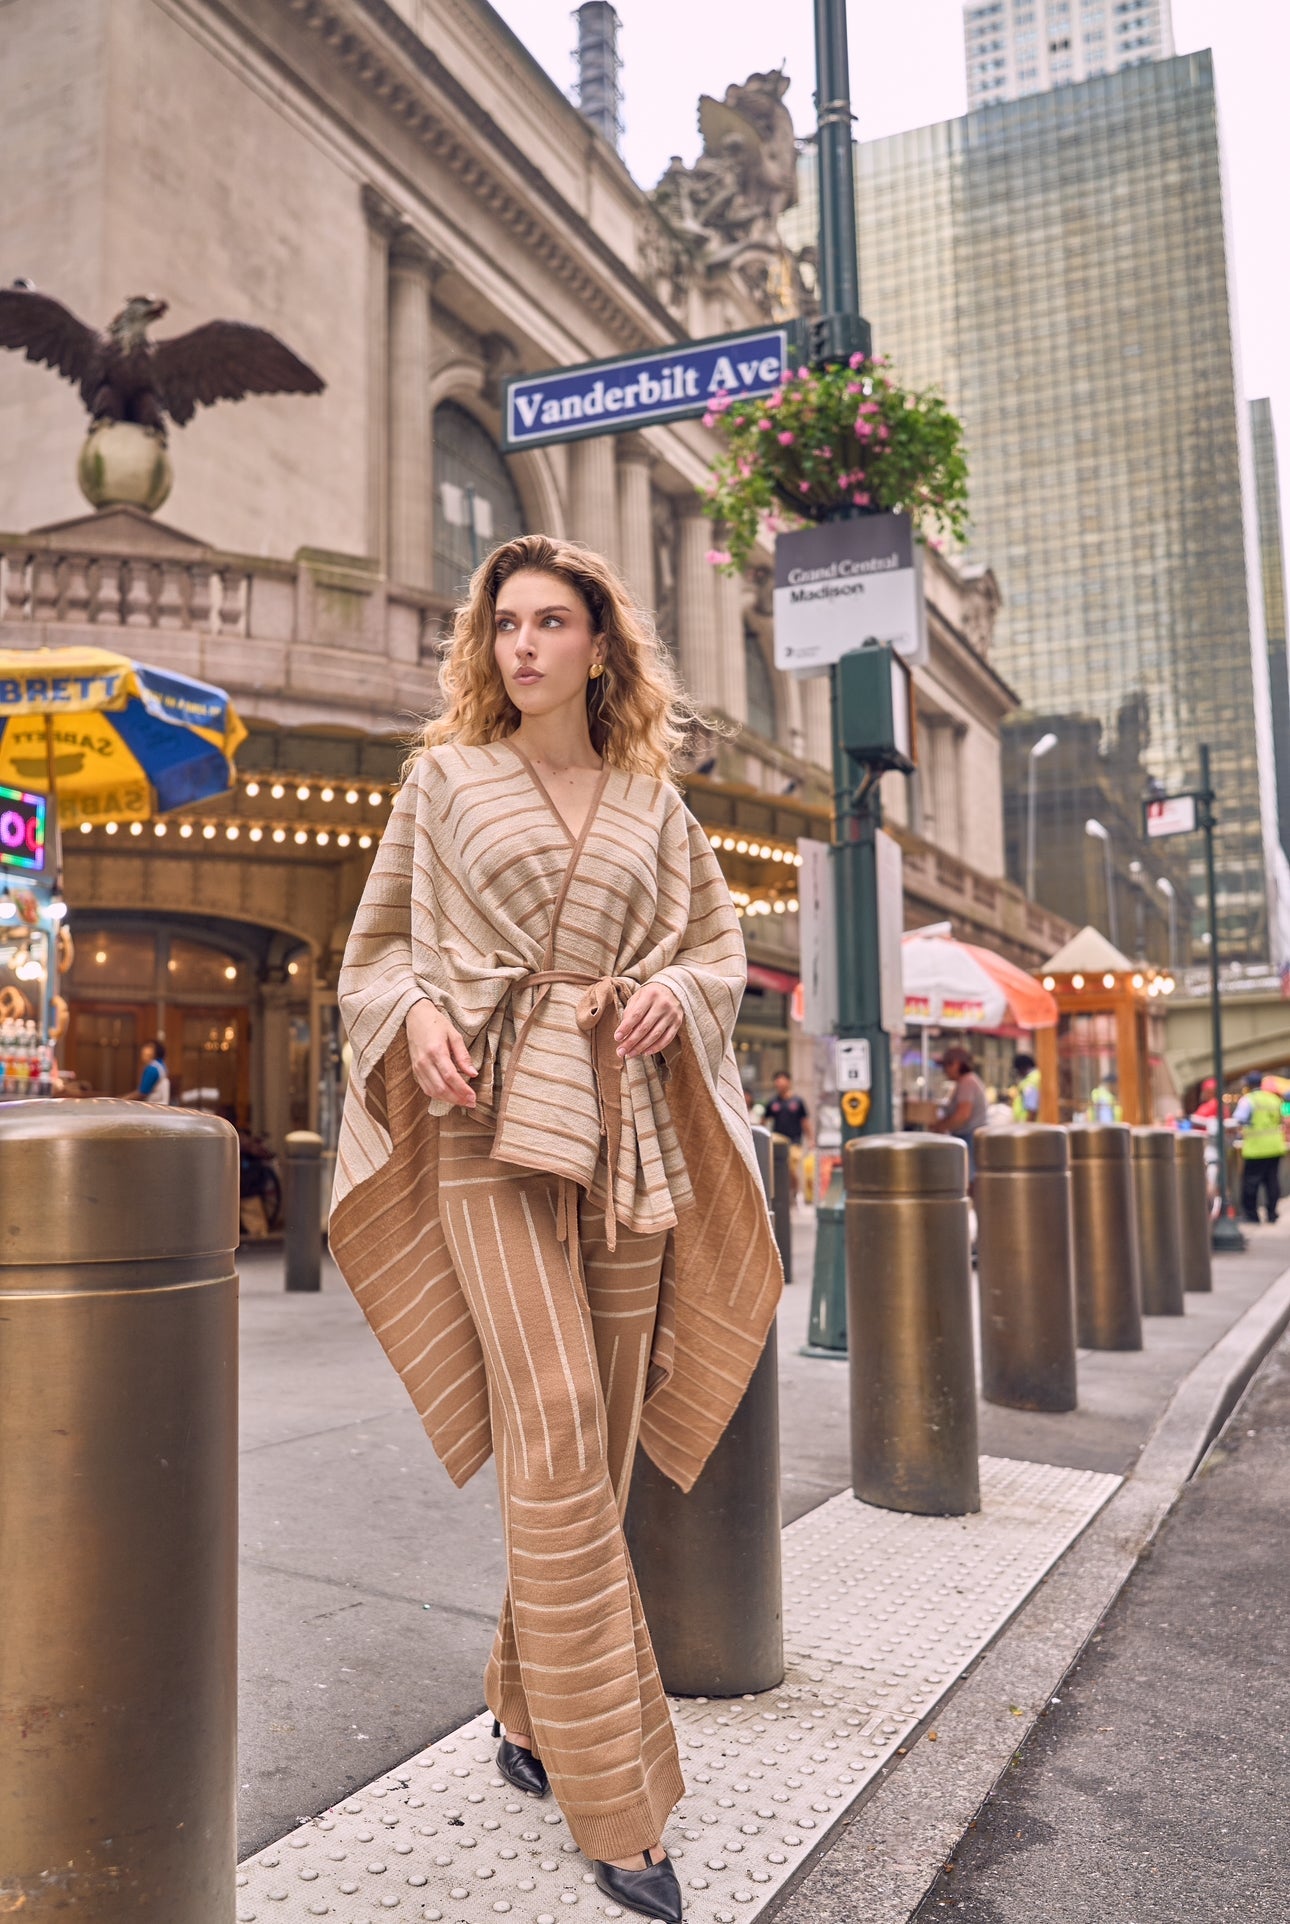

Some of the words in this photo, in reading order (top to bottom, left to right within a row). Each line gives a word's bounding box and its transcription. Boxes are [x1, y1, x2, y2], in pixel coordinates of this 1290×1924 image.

[515, 365, 699, 428] Vanderbilt
[706, 356, 781, 393] Ave
[788, 561, 837, 585] Grand
[838, 553, 899, 576] Central
[790, 582, 865, 603] Madison
